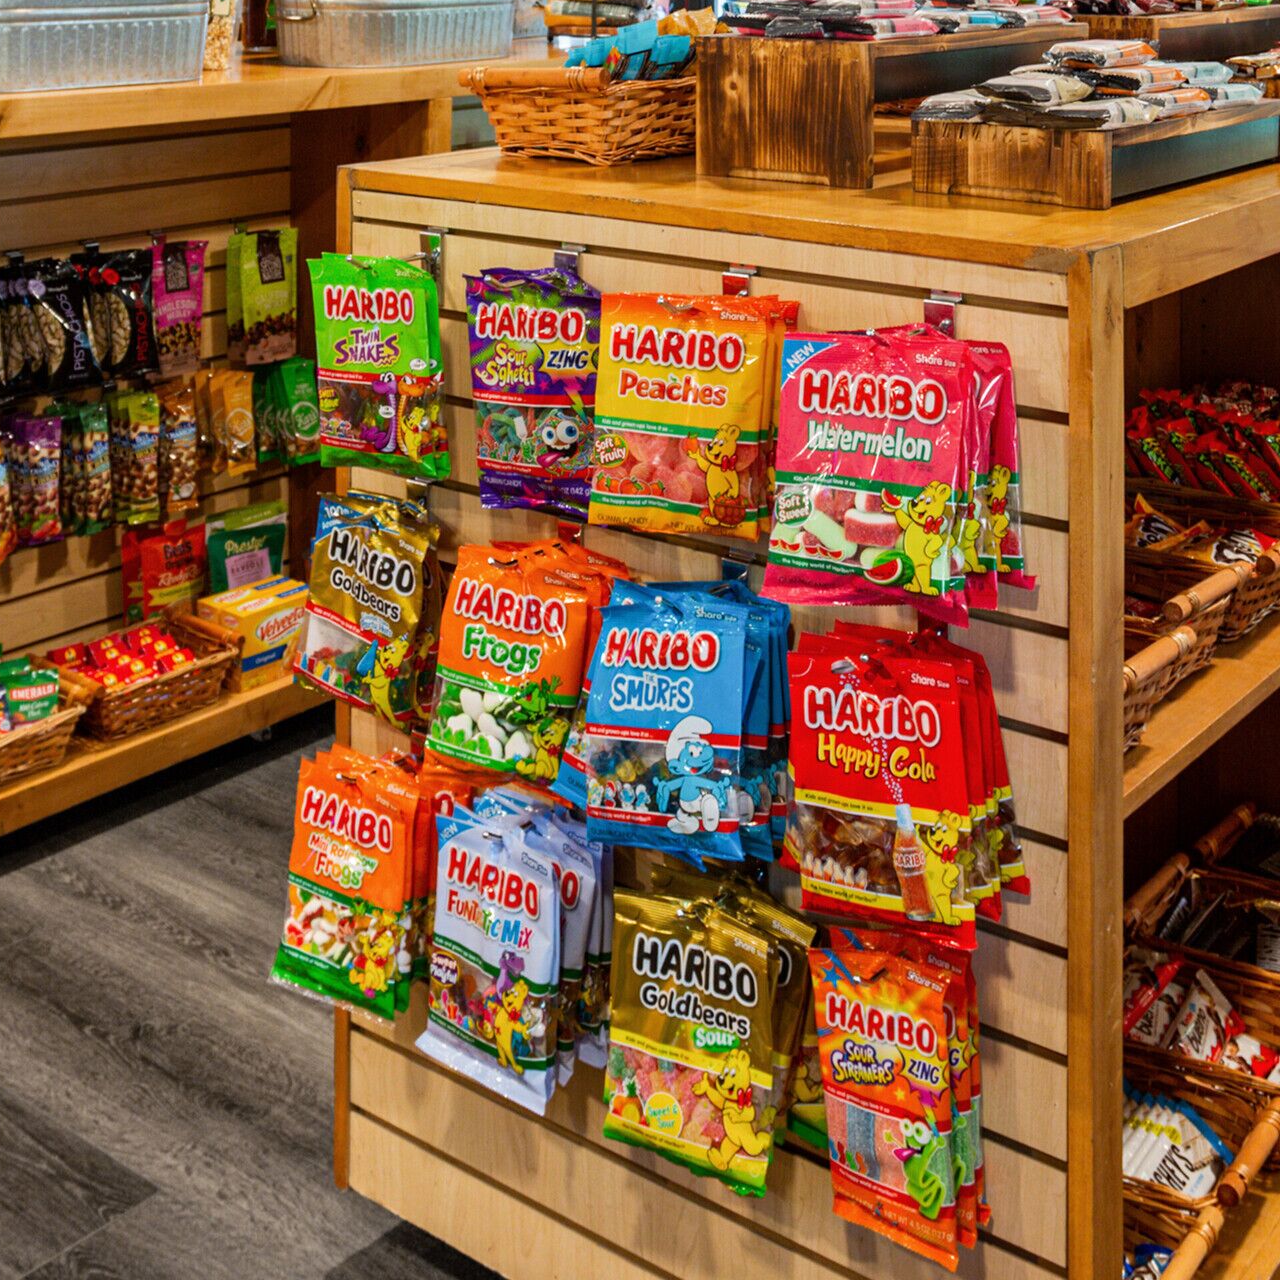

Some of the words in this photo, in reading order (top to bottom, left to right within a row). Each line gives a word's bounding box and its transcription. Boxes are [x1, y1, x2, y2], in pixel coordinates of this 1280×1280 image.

[324, 284, 416, 326] HARIBO
[476, 302, 586, 345] HARIBO
[720, 311, 746, 322] Share
[334, 334, 401, 366] SNAKES
[351, 328, 381, 346] TWIN
[495, 341, 528, 368] Sour
[610, 323, 745, 373] HARIBO
[785, 342, 815, 368] NEW
[915, 353, 943, 366] Share
[619, 370, 728, 408] Peaches
[799, 367, 948, 425] HARIBO
[595, 437, 614, 451] Soft
[600, 447, 627, 464] Fruity
[807, 420, 933, 463] Watermelon
[778, 495, 801, 510] Soft
[328, 527, 416, 596] HARIBO
[331, 568, 400, 621] Goldbears
[454, 578, 567, 637] HARIBO
[258, 606, 306, 641] Velveeta
[463, 624, 542, 676] Frogs
[602, 627, 720, 672] HARIBO
[11, 684, 55, 700] EMERALD
[610, 673, 694, 713] SMURFS
[910, 673, 935, 686] Share
[937, 680, 950, 689] Size
[804, 685, 941, 747] HARIBO
[302, 786, 393, 853] HARIBO
[308, 832, 330, 853] Mini
[330, 842, 377, 873] Rainbow
[315, 852, 362, 889] Frogs
[446, 847, 540, 920] HARIBO
[633, 932, 759, 1007] HARIBO
[640, 982, 751, 1040] Goldbears
[825, 991, 938, 1058] HARIBO
[695, 1028, 736, 1049] Sour
[844, 1039, 877, 1066] SOUR
[831, 1051, 895, 1086] STREAMERS
[908, 1057, 940, 1084] Z!NG
